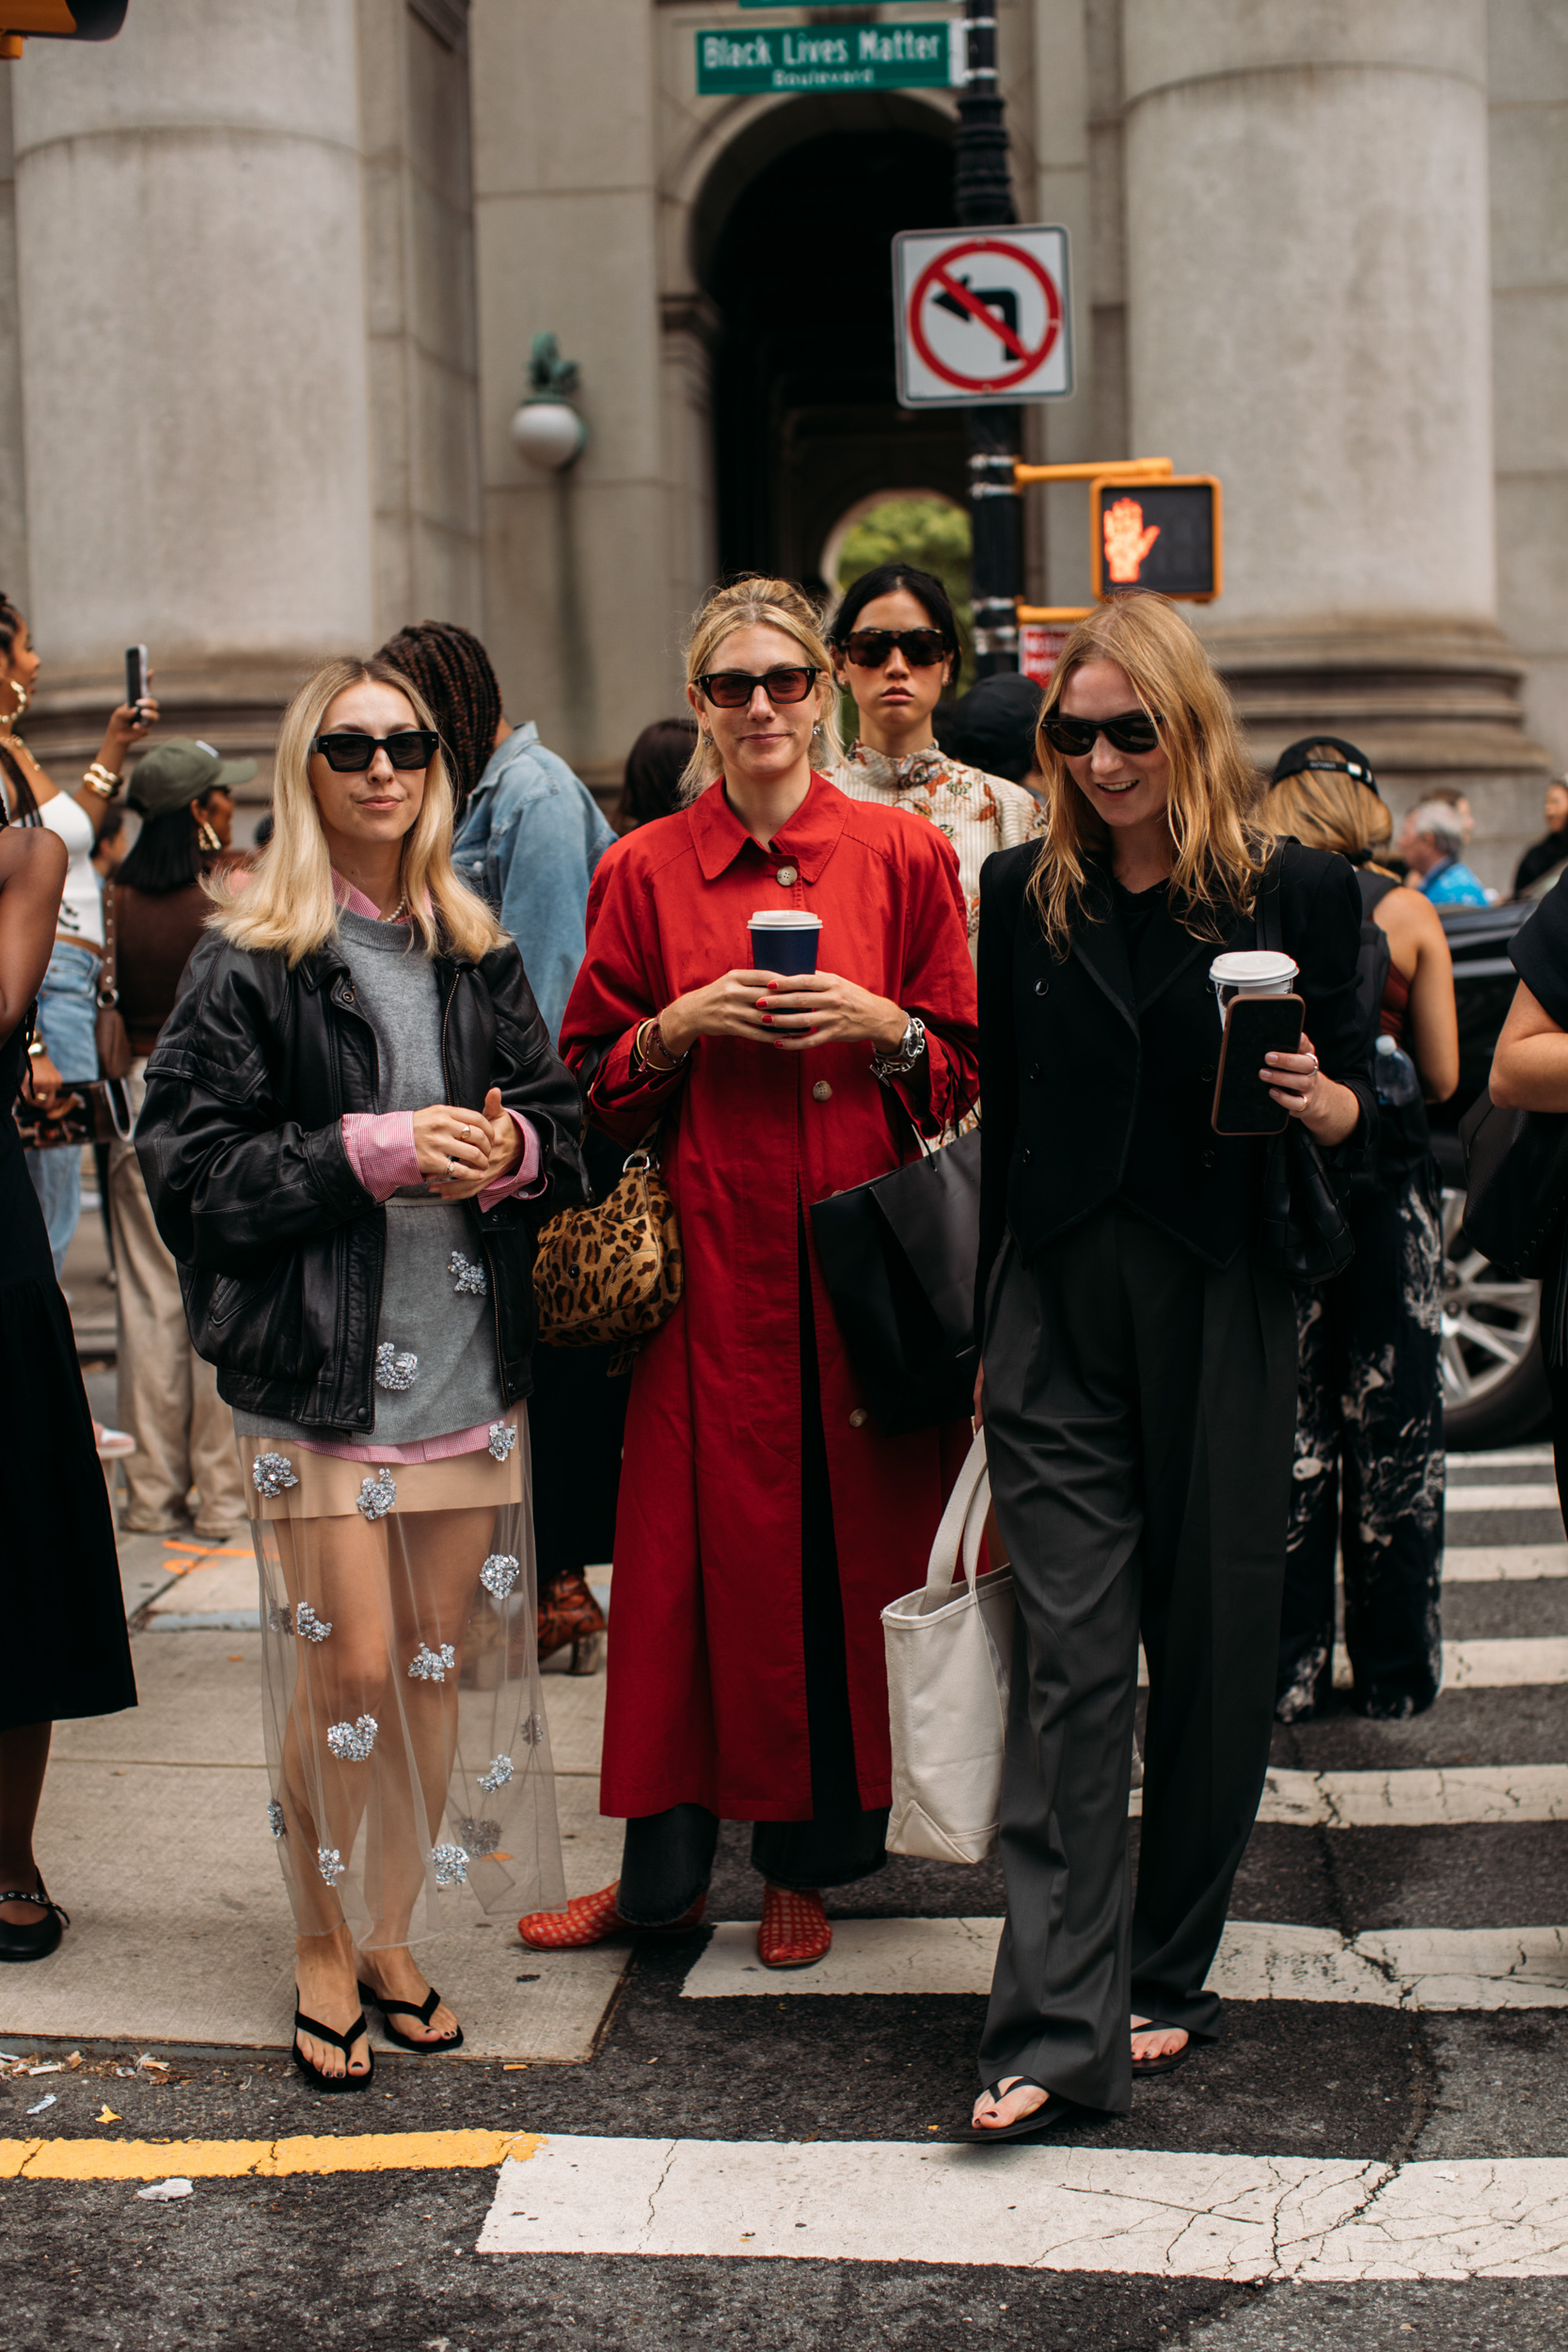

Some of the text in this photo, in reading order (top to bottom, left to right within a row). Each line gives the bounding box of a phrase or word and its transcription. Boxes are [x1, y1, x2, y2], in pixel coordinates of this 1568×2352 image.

[704, 30, 940, 68] Black Lives Matter
[773, 69, 874, 87] Boulevard
